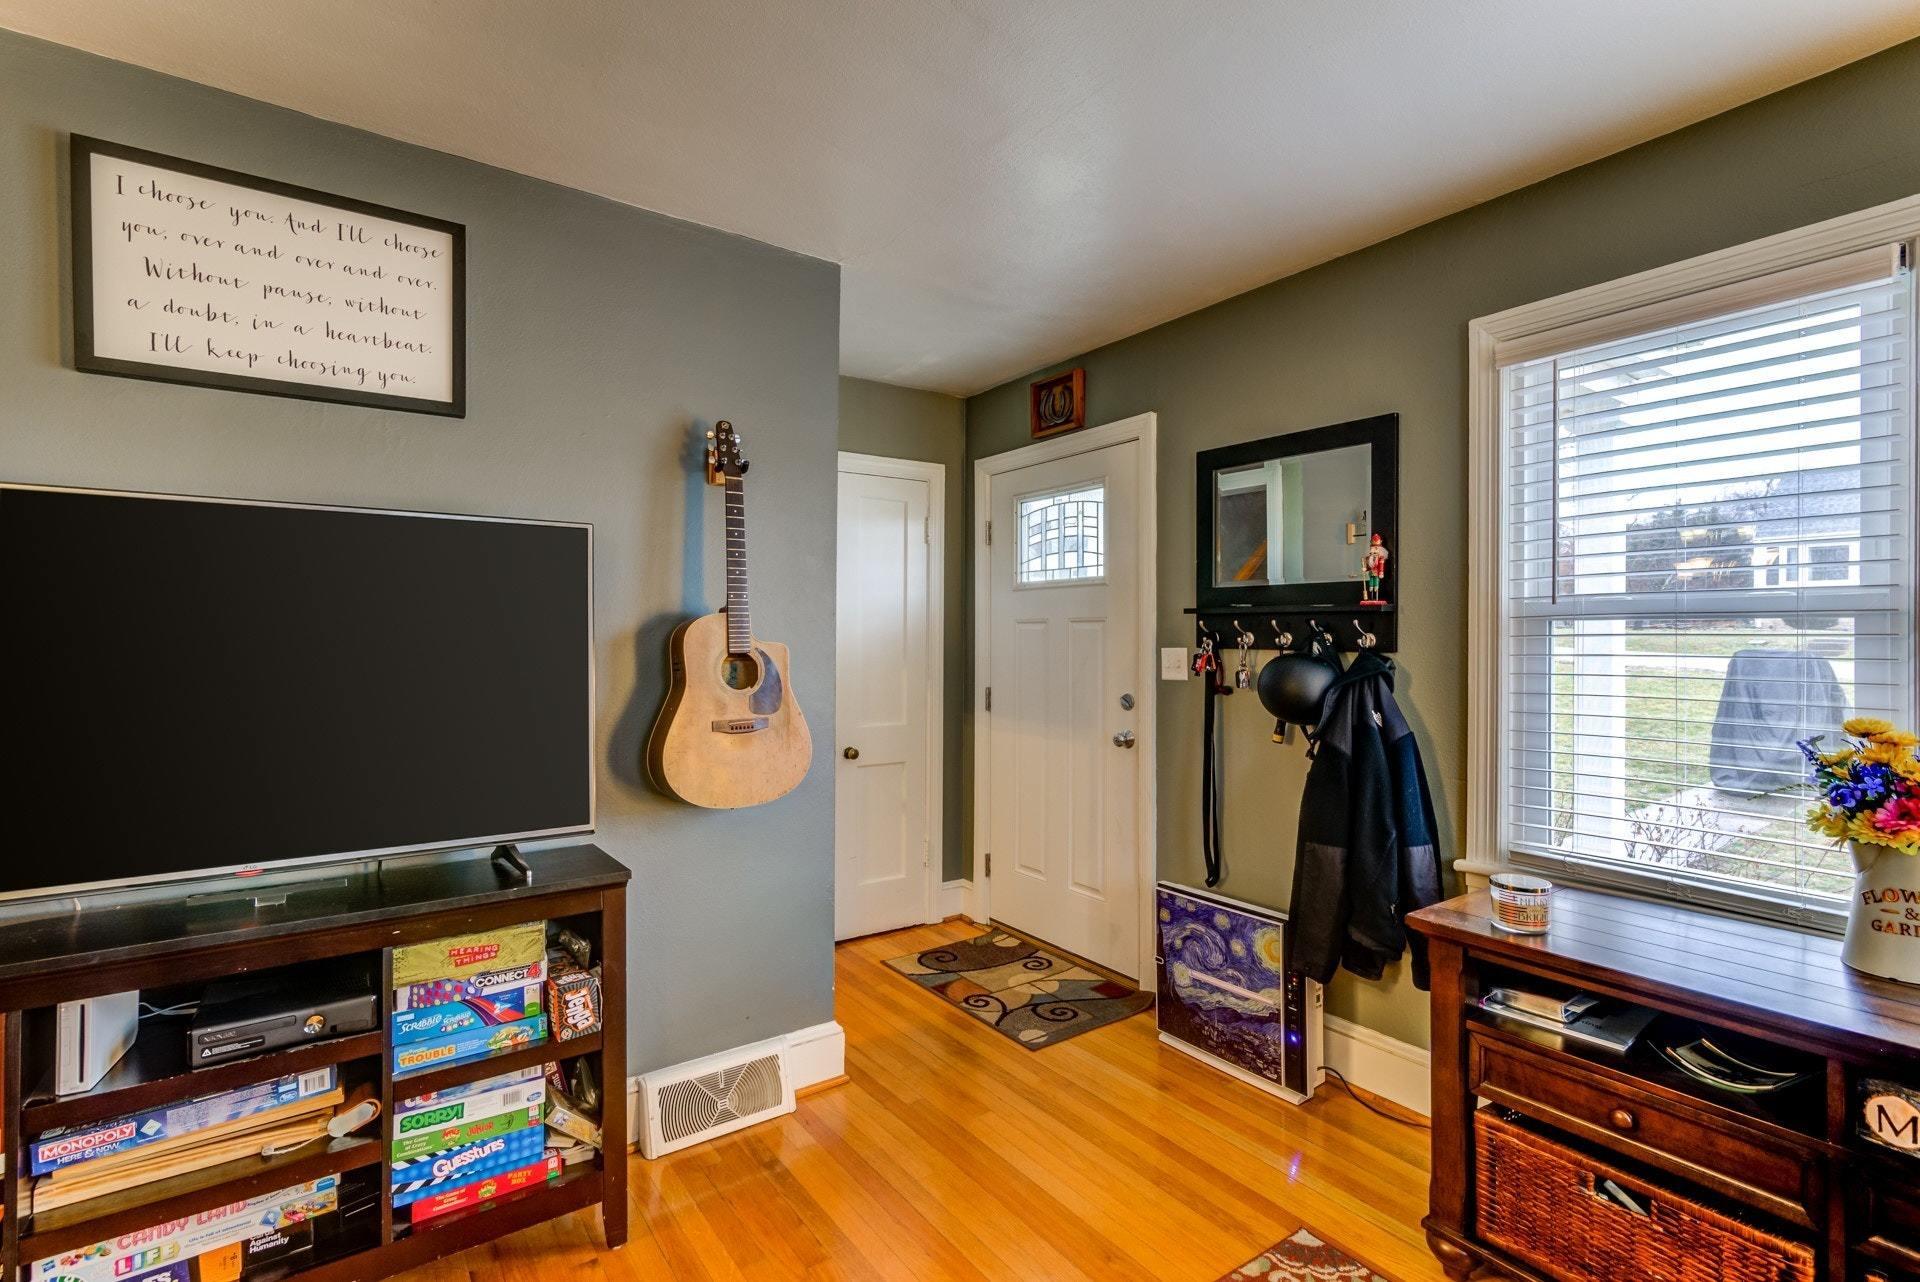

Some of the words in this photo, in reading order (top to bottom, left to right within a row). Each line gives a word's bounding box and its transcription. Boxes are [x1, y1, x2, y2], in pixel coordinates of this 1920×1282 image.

[116, 175, 124, 195] I
[136, 179, 219, 210] choose
[281, 212, 326, 237] And
[337, 223, 373, 244] I'll
[382, 235, 444, 261] choose
[178, 231, 227, 249] over
[232, 238, 285, 261] and
[296, 254, 338, 271] over
[341, 258, 390, 280] and
[144, 254, 251, 289] Without
[344, 296, 427, 320] without
[127, 296, 150, 311] a
[250, 314, 285, 331] in
[292, 320, 313, 336] a
[147, 330, 192, 353] I'll
[207, 338, 264, 368] keep
[275, 350, 371, 386] choosing
[451, 944, 499, 956] HEARING
[456, 952, 496, 965] THINGS
[474, 967, 529, 988] CONNECT
[398, 1013, 442, 1034] SCRABBLE
[565, 987, 594, 1031] Jenga
[399, 1045, 457, 1067] TROUBLE
[400, 1102, 464, 1133] SORRY!
[1877, 1104, 1919, 1145] M
[42, 1124, 133, 1160] MONOPOLY
[57, 1151, 82, 1165] HERE
[84, 1148, 94, 1158] &
[95, 1142, 120, 1155] NOW
[250, 1232, 281, 1247] Against
[250, 1236, 289, 1254] Humanity
[115, 1242, 179, 1277] LIFE
